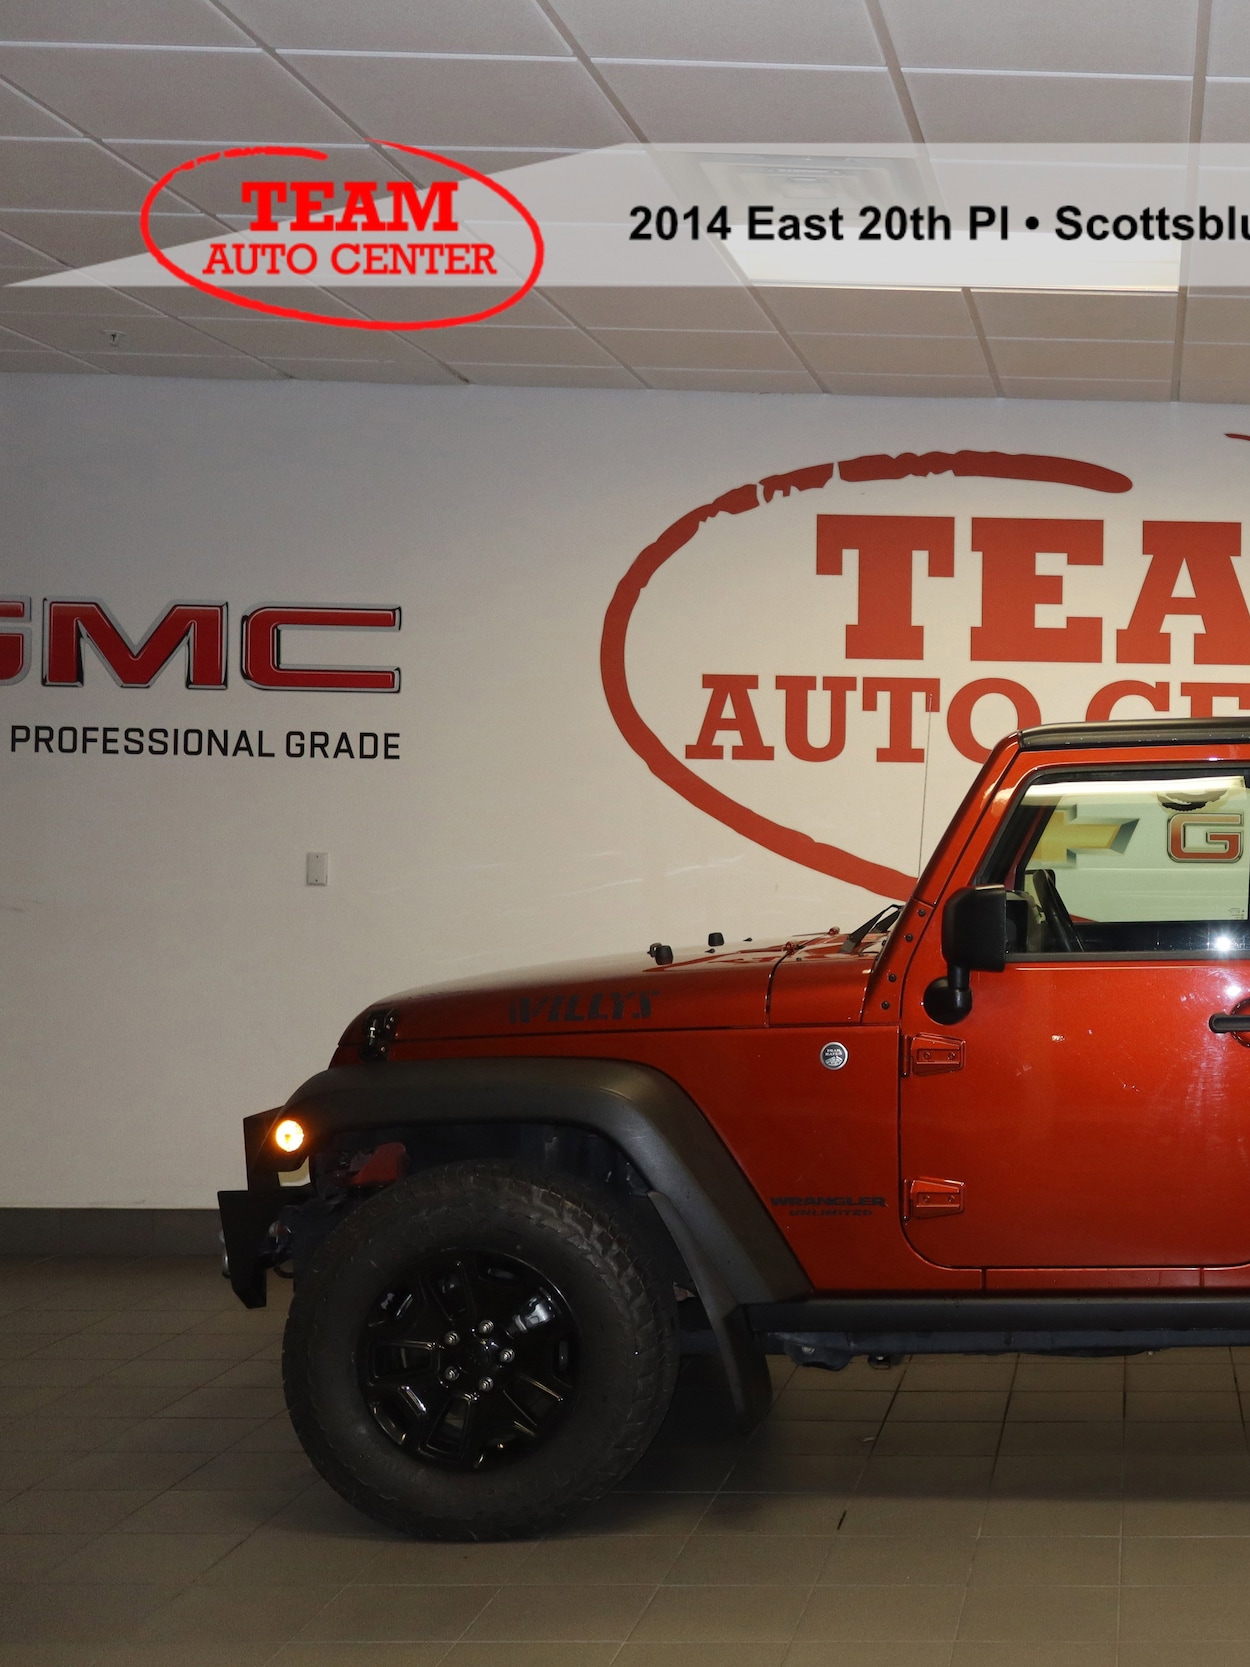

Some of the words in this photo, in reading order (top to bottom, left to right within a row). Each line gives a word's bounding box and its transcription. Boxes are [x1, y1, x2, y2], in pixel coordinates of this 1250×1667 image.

[0, 595, 401, 693] MC
[685, 674, 1042, 764] AUTO
[10, 724, 276, 758] PROFESSIONAL
[285, 730, 401, 760] GRADE
[508, 989, 661, 1025] WILLYS
[770, 1196, 887, 1207] WRANGLER
[789, 1209, 873, 1217] UNLIMITED
